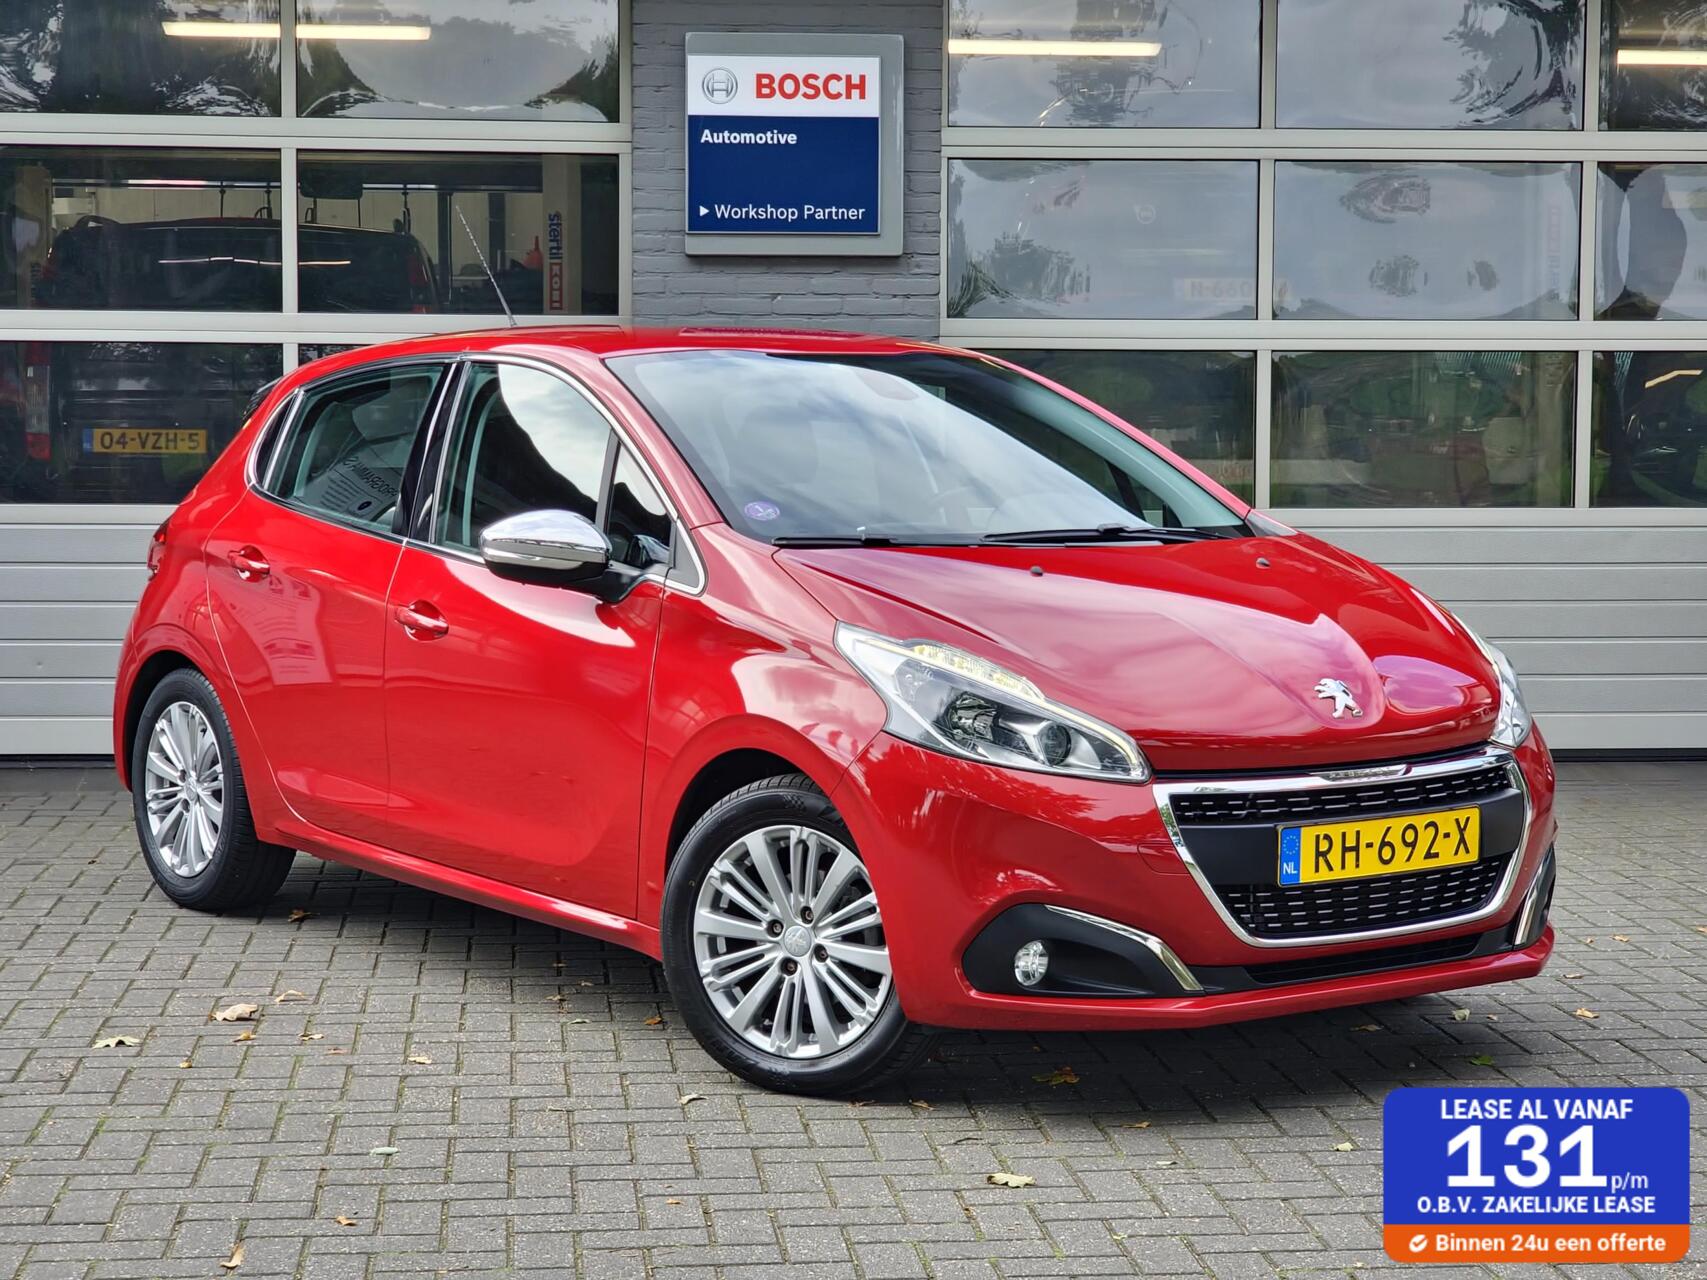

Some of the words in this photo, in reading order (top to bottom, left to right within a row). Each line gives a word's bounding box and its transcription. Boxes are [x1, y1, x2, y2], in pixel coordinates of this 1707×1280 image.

[755, 73, 867, 101] BOSCH
[700, 129, 798, 145] Automotive
[714, 204, 799, 222] Workshop
[804, 204, 866, 220] Partner
[100, 431, 200, 450] 04-VZH-5
[1314, 816, 1471, 874] RH-692-X
[1282, 862, 1298, 875] NL
